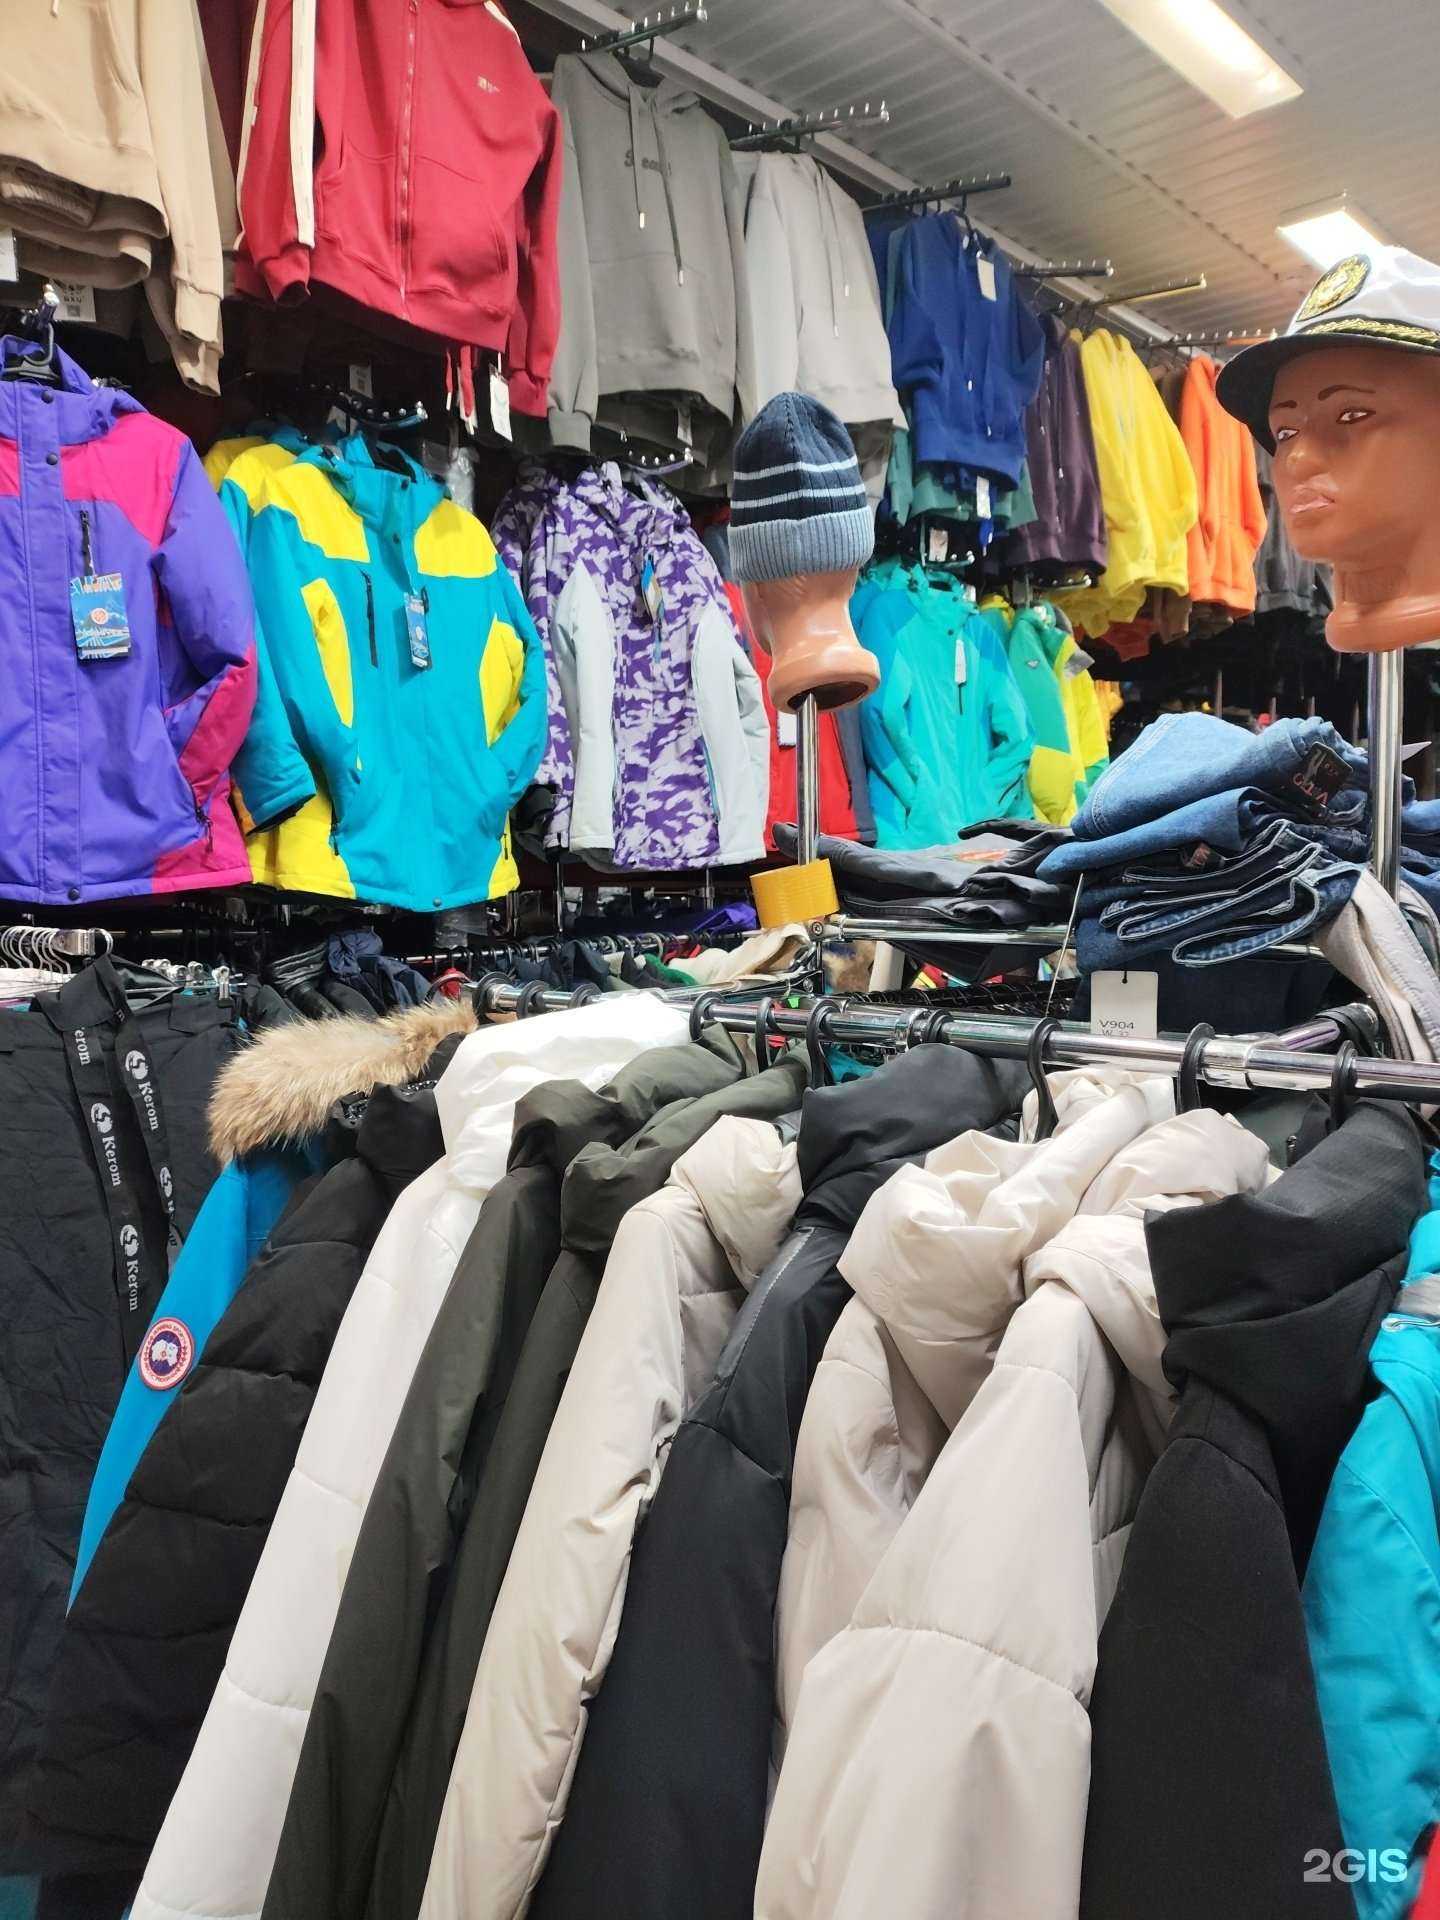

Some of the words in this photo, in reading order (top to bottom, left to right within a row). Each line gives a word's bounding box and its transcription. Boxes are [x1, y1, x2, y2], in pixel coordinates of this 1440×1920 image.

[74, 1026, 91, 1066] erom
[1099, 1019, 1134, 1029] V904
[138, 1081, 159, 1131] Kerom
[102, 1135, 122, 1187] Kerom
[126, 1259, 139, 1313] Kerom
